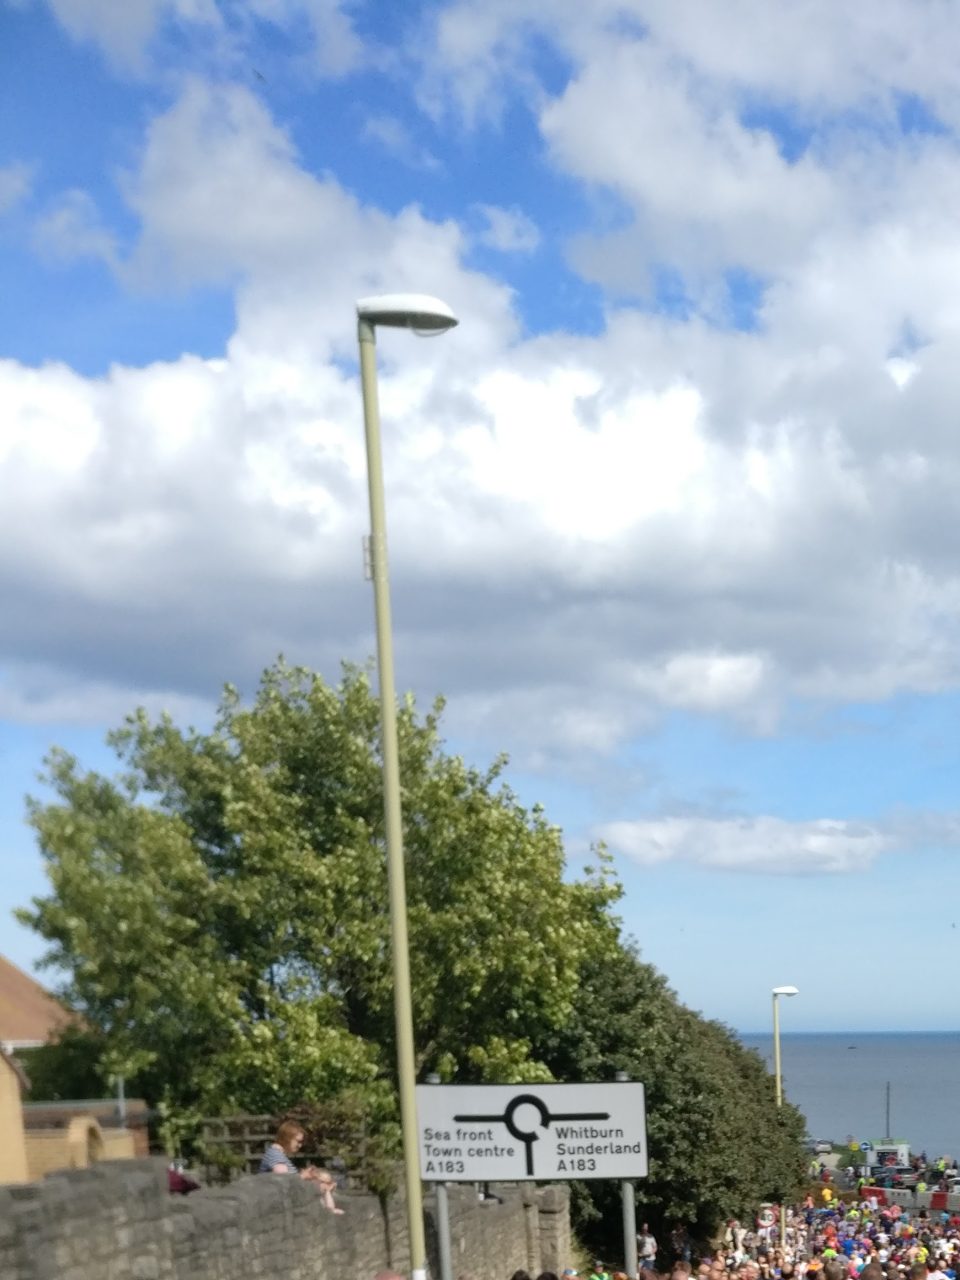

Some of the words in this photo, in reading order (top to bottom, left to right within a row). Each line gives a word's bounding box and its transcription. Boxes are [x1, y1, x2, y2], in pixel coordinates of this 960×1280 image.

[424, 1128, 450, 1141] Sea
[456, 1128, 494, 1141] front
[555, 1127, 624, 1139] Whitburn
[424, 1144, 462, 1157] Town
[467, 1145, 515, 1157] centre
[556, 1142, 641, 1155] Sunderland
[426, 1161, 465, 1173] A183
[557, 1158, 596, 1171] A183
